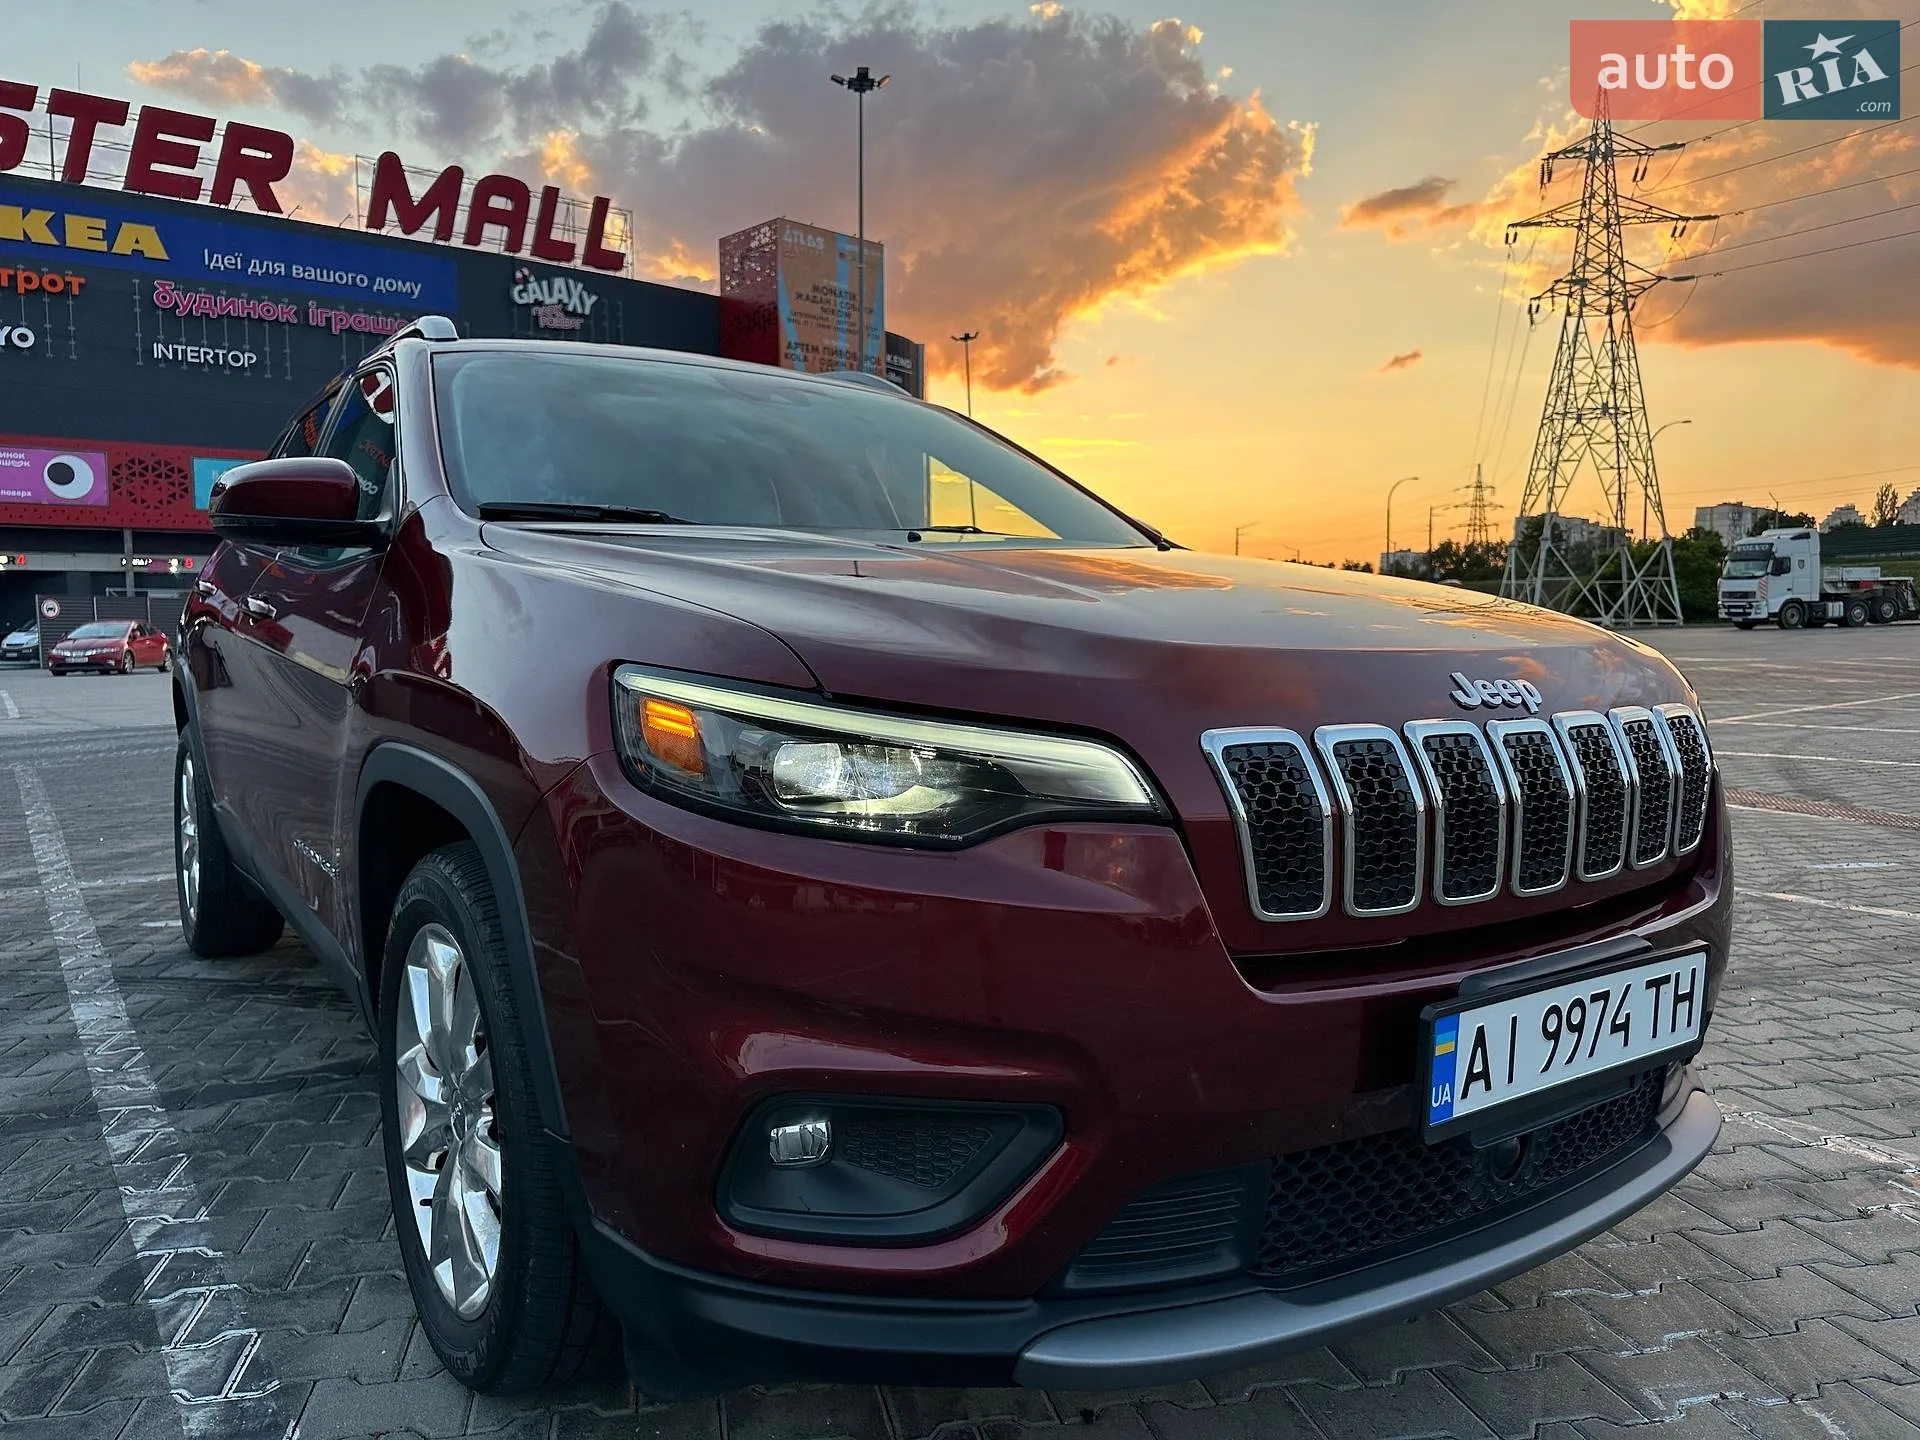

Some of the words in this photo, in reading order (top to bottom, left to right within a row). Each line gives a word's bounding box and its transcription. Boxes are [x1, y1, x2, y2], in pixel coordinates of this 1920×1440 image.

[366, 151, 626, 272] MALL
[204, 248, 243, 271] Ідеї
[247, 259, 285, 276] для
[291, 264, 368, 288] вашого
[372, 276, 422, 299] дому
[153, 279, 298, 324] будинок
[513, 276, 599, 315] GALAXY
[152, 342, 257, 368] INTERTOP
[1449, 672, 1542, 714] Jeep
[1460, 1016, 1518, 1100] AI
[1540, 982, 1633, 1075] 9974
[1645, 967, 1697, 1040] TH
[1432, 1083, 1451, 1107] UA
